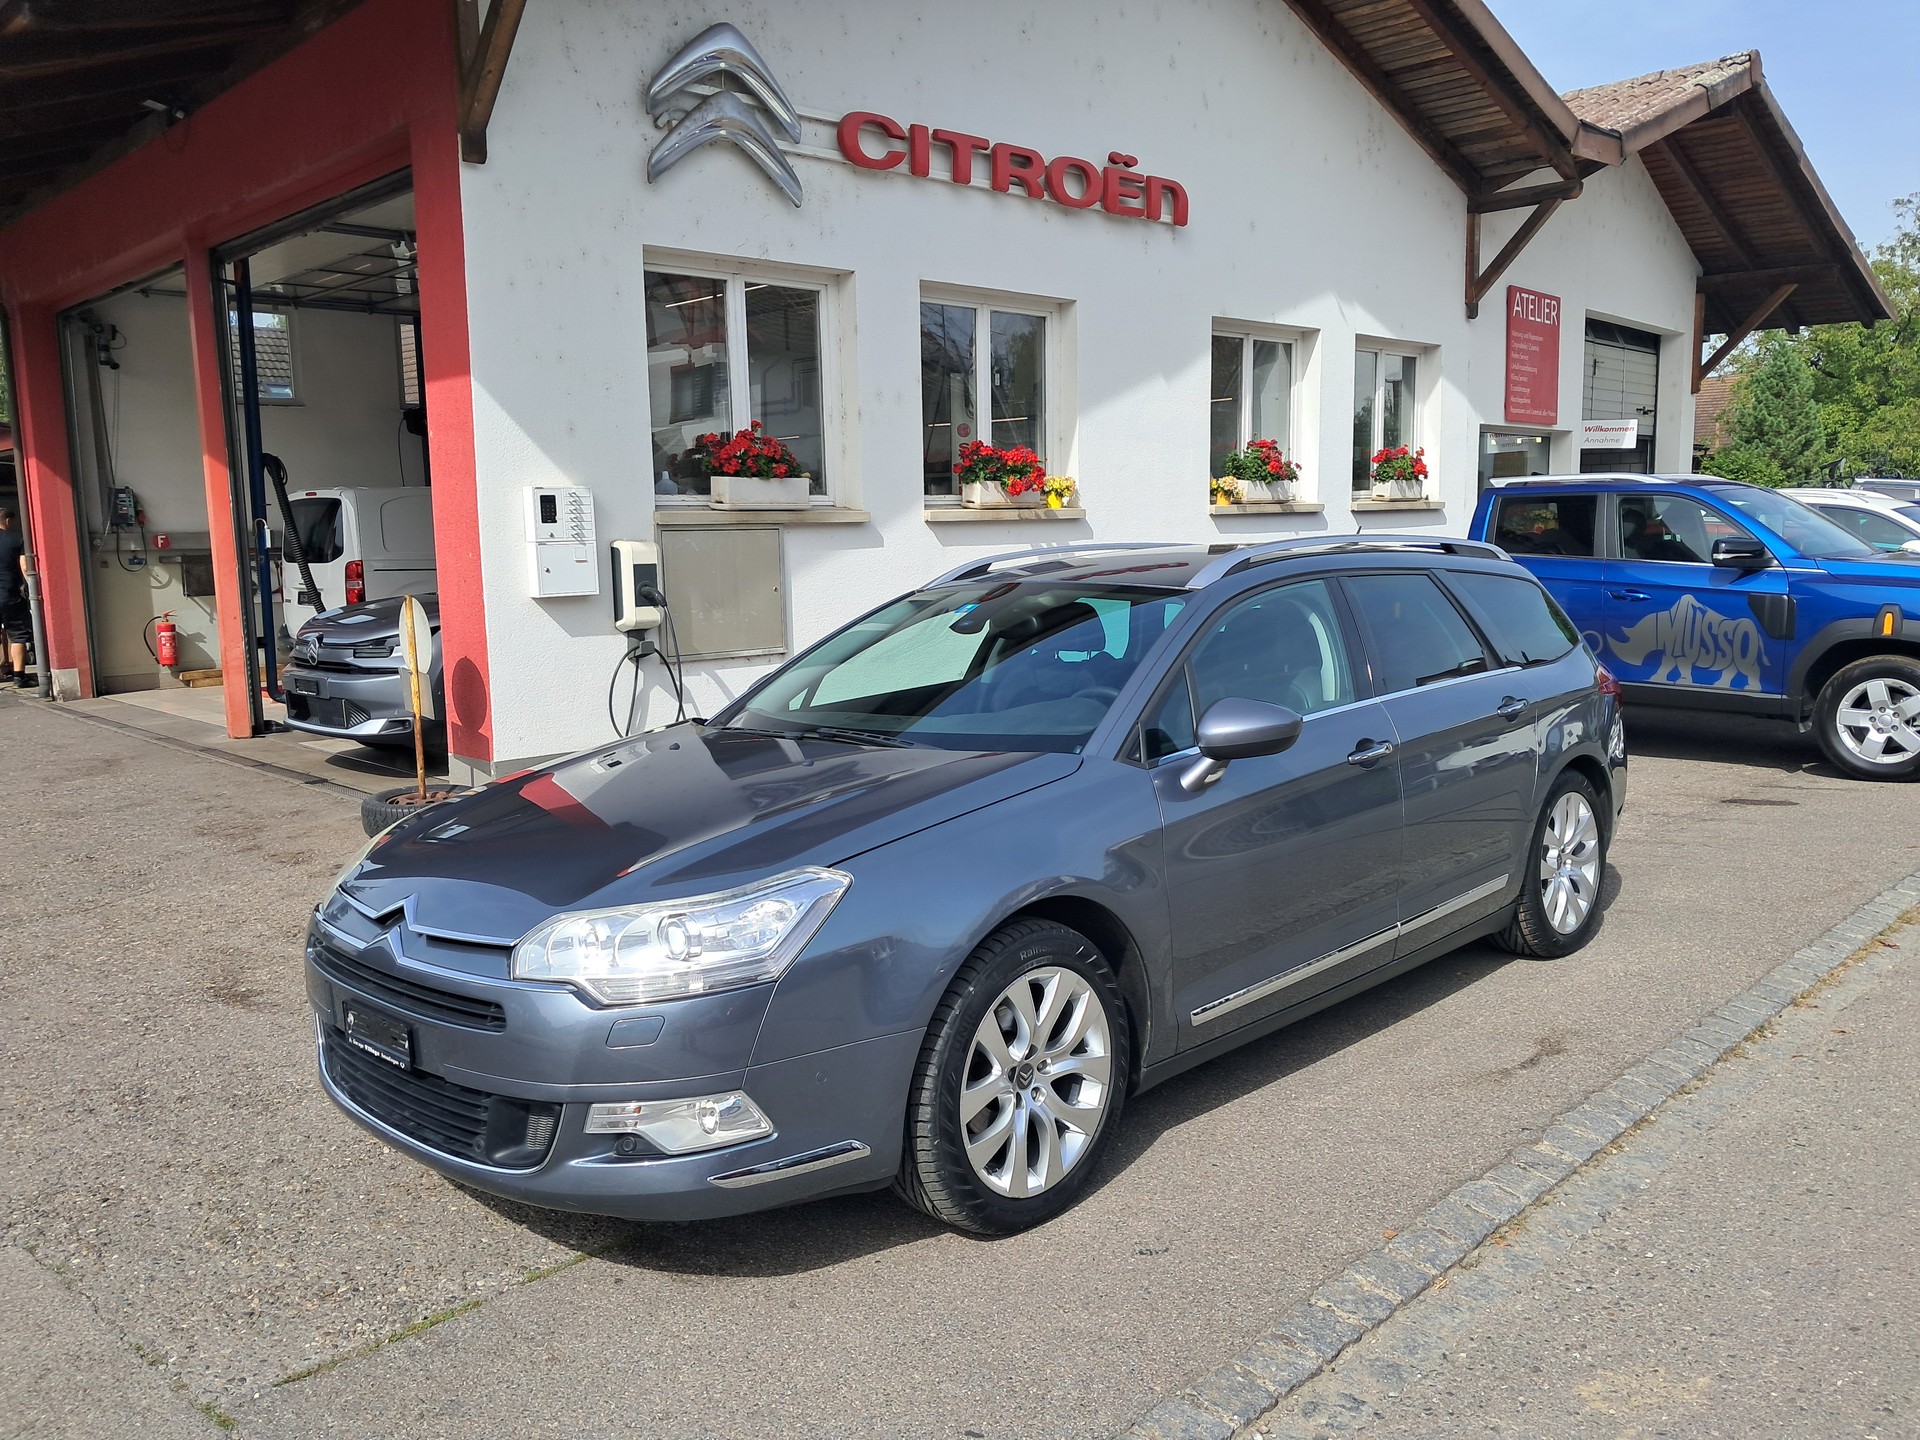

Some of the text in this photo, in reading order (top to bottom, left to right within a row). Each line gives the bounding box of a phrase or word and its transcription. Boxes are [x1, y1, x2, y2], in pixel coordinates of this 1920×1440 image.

[1513, 292, 1558, 326] ATELIER
[1584, 425, 1635, 433] Willkommen
[1584, 436, 1621, 444] Annahme
[157, 535, 166, 548] F
[1657, 595, 1758, 674] MUSSO
